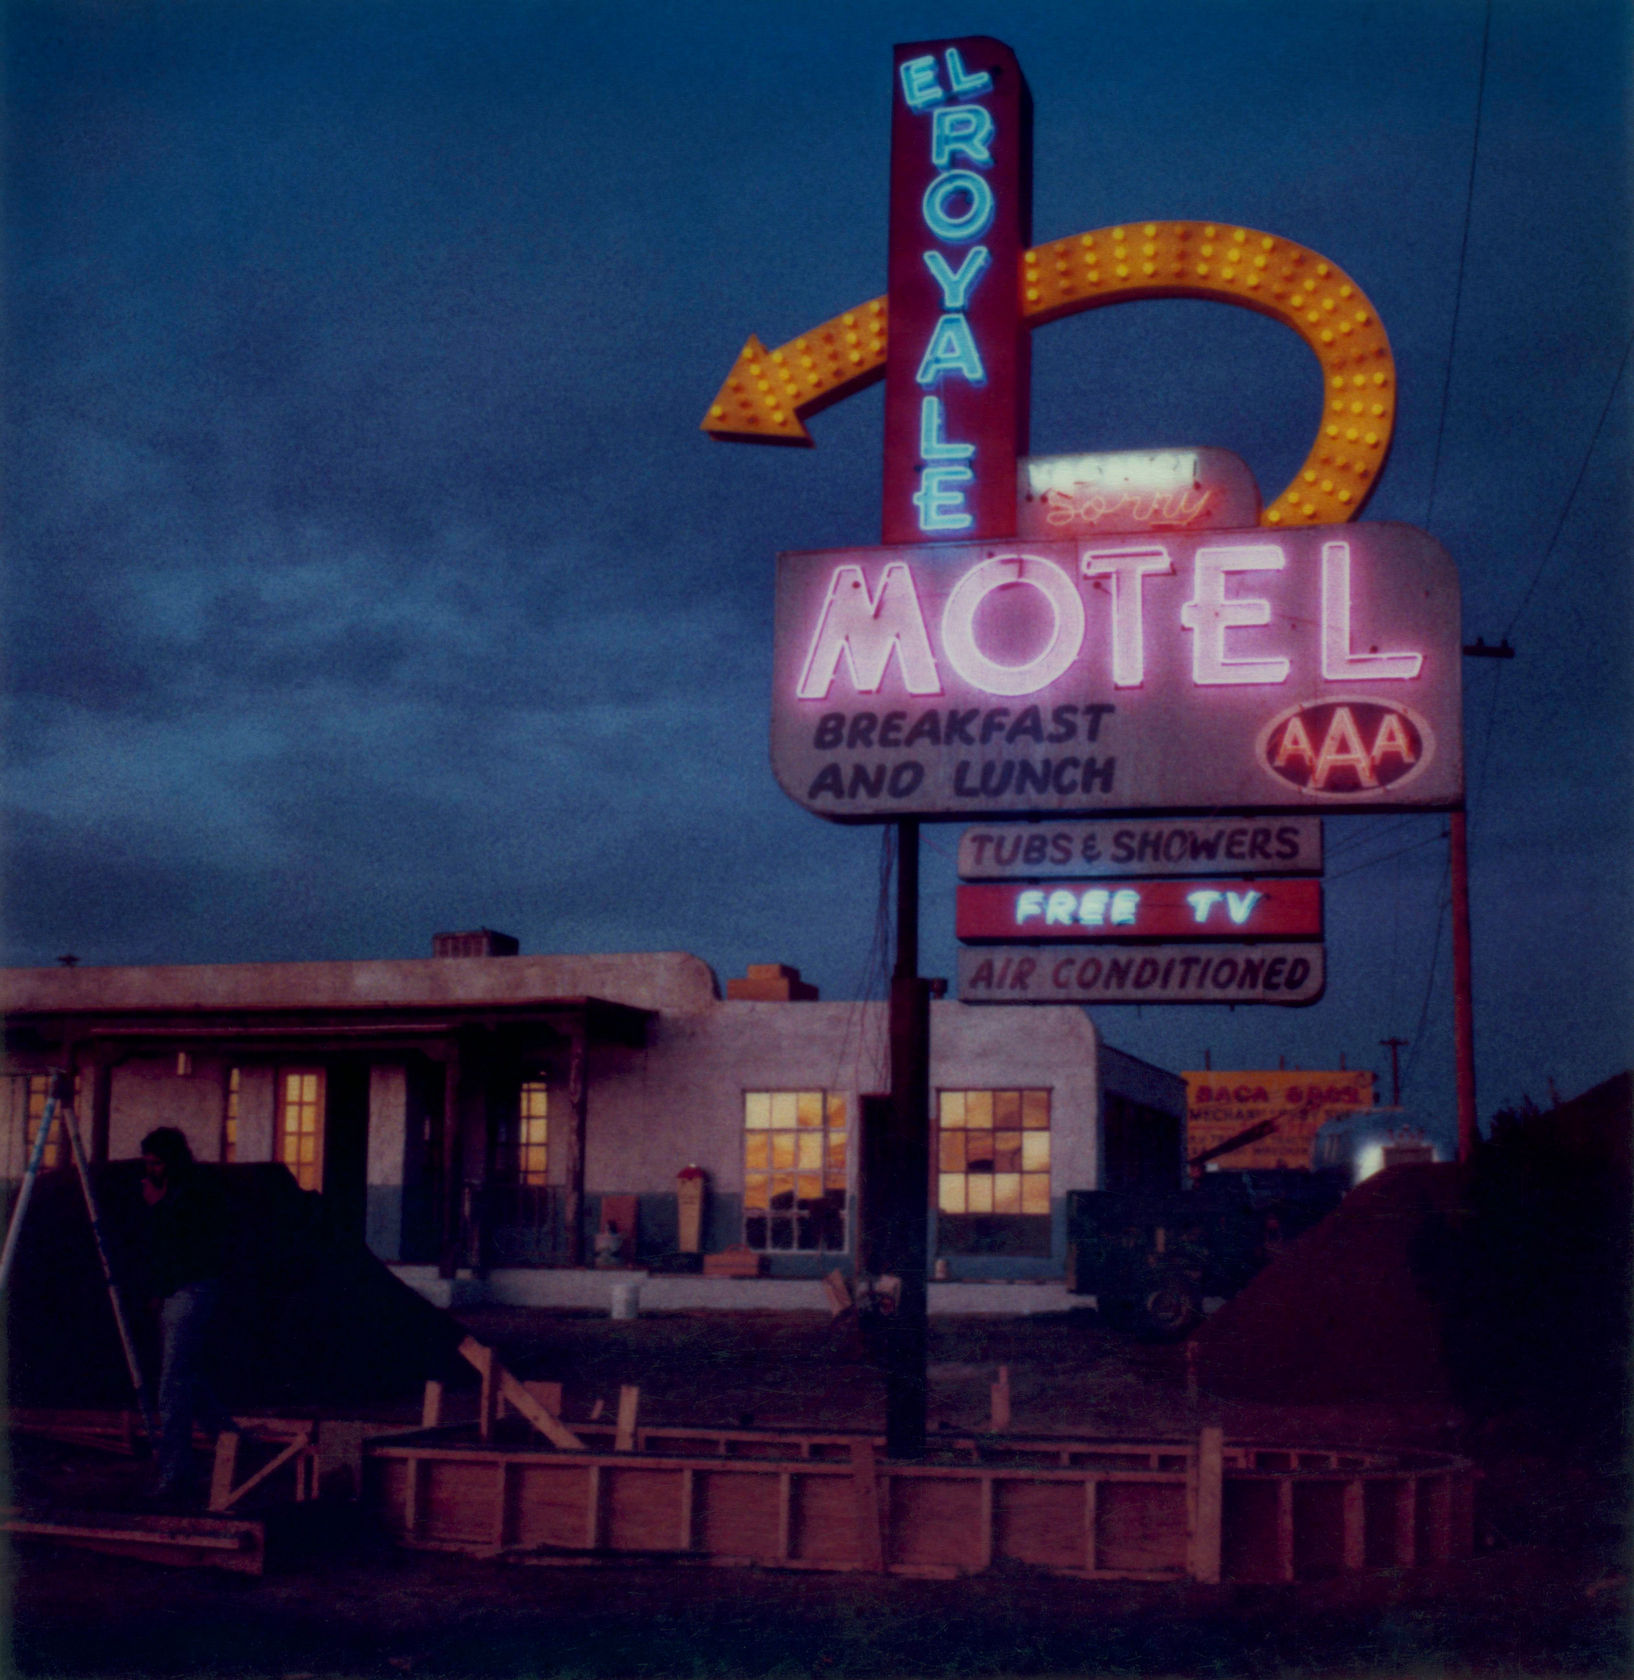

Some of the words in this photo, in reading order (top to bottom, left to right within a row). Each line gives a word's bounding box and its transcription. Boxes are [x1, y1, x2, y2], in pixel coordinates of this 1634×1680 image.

[900, 48, 991, 111] EL
[914, 104, 996, 532] ROYALE
[795, 541, 1424, 699] MOTEL
[813, 704, 1115, 749] BREAKFAST
[1273, 706, 1416, 788] AAA
[808, 761, 924, 799] AND
[954, 756, 1116, 797] LUNCH
[970, 833, 1073, 866] TUBS
[1083, 833, 1103, 864] &
[1110, 826, 1301, 864] SHOWERS
[1014, 889, 1141, 925] FREE
[1186, 889, 1270, 924] TV
[969, 957, 1036, 991] AIR
[1053, 957, 1311, 991] CONDITIONED
